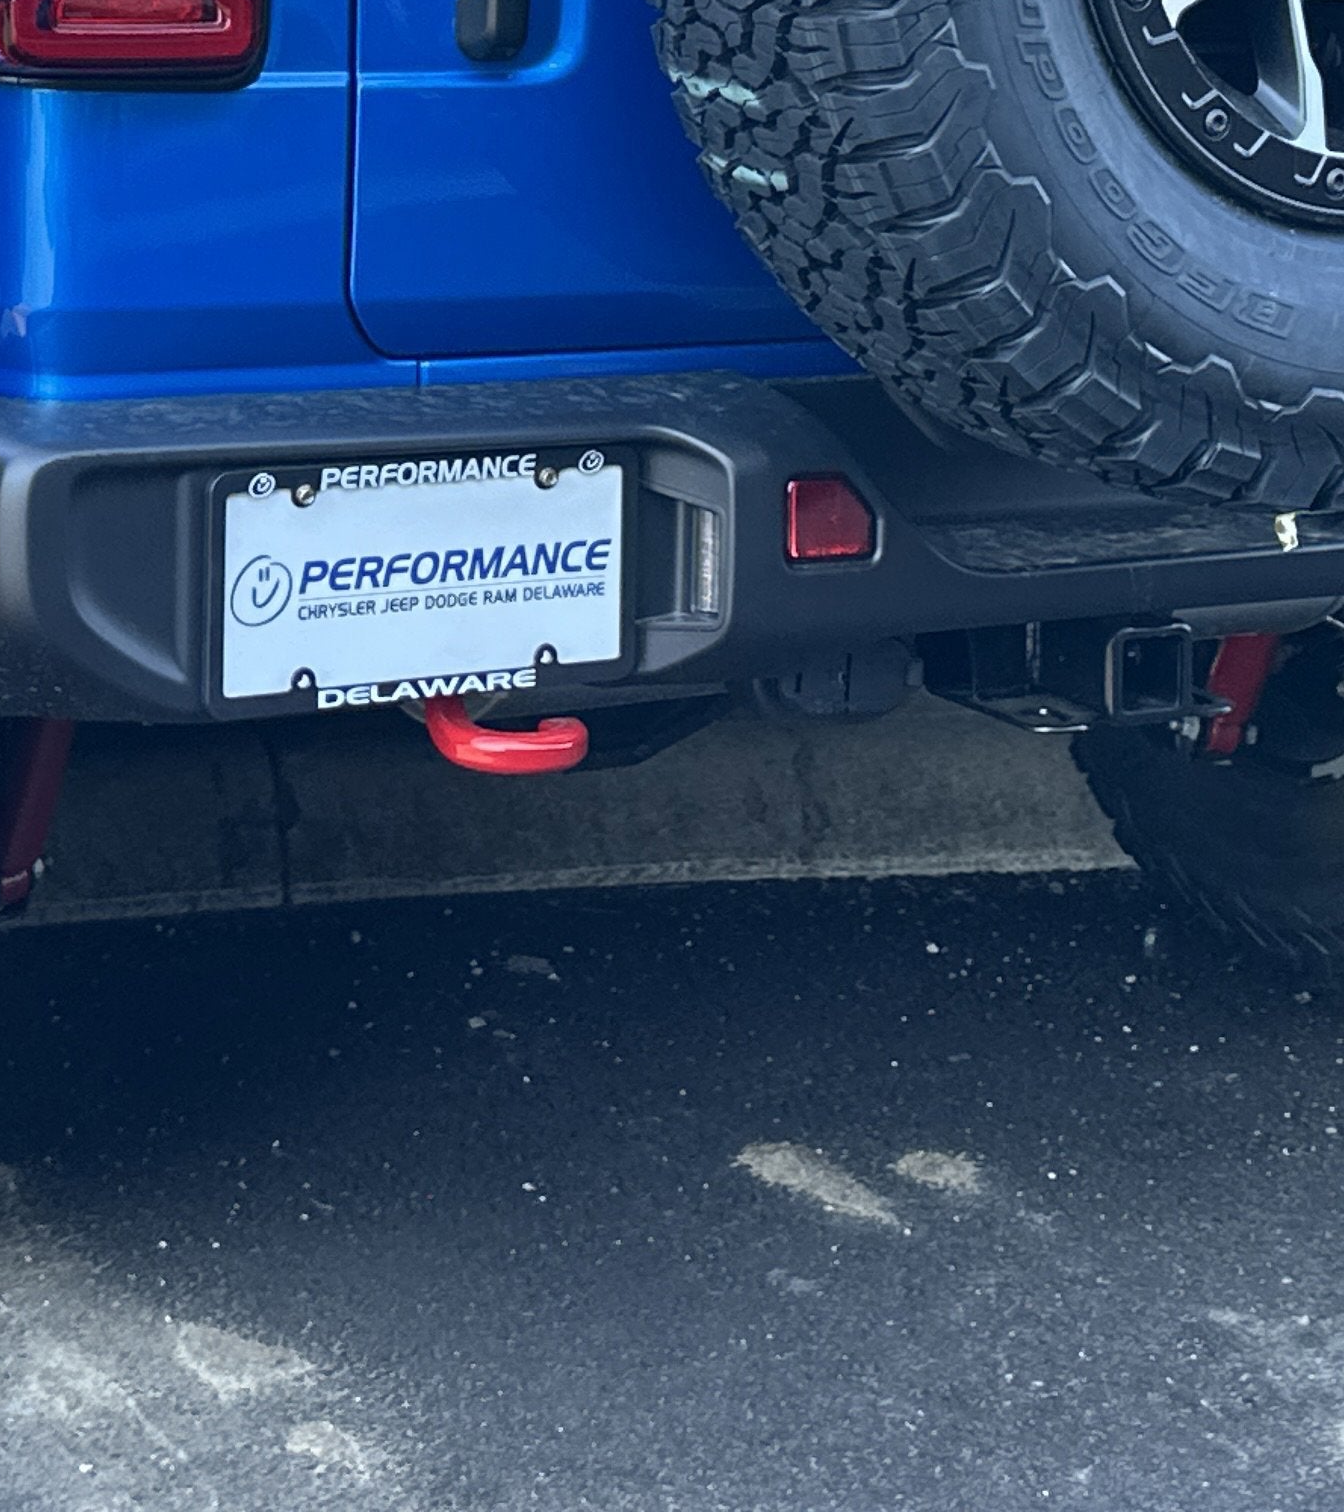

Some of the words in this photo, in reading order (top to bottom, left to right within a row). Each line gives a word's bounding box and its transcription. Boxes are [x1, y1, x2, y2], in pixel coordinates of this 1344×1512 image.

[320, 453, 538, 491] PERFORMANCE
[298, 538, 612, 595] PERFORMANCE
[297, 600, 376, 621] CHRYSLER
[380, 597, 419, 614] JEEP
[424, 592, 478, 611] DODGE
[482, 589, 518, 604] RAM
[523, 581, 606, 602] DELAWARE
[317, 668, 537, 710] DELAWARE
